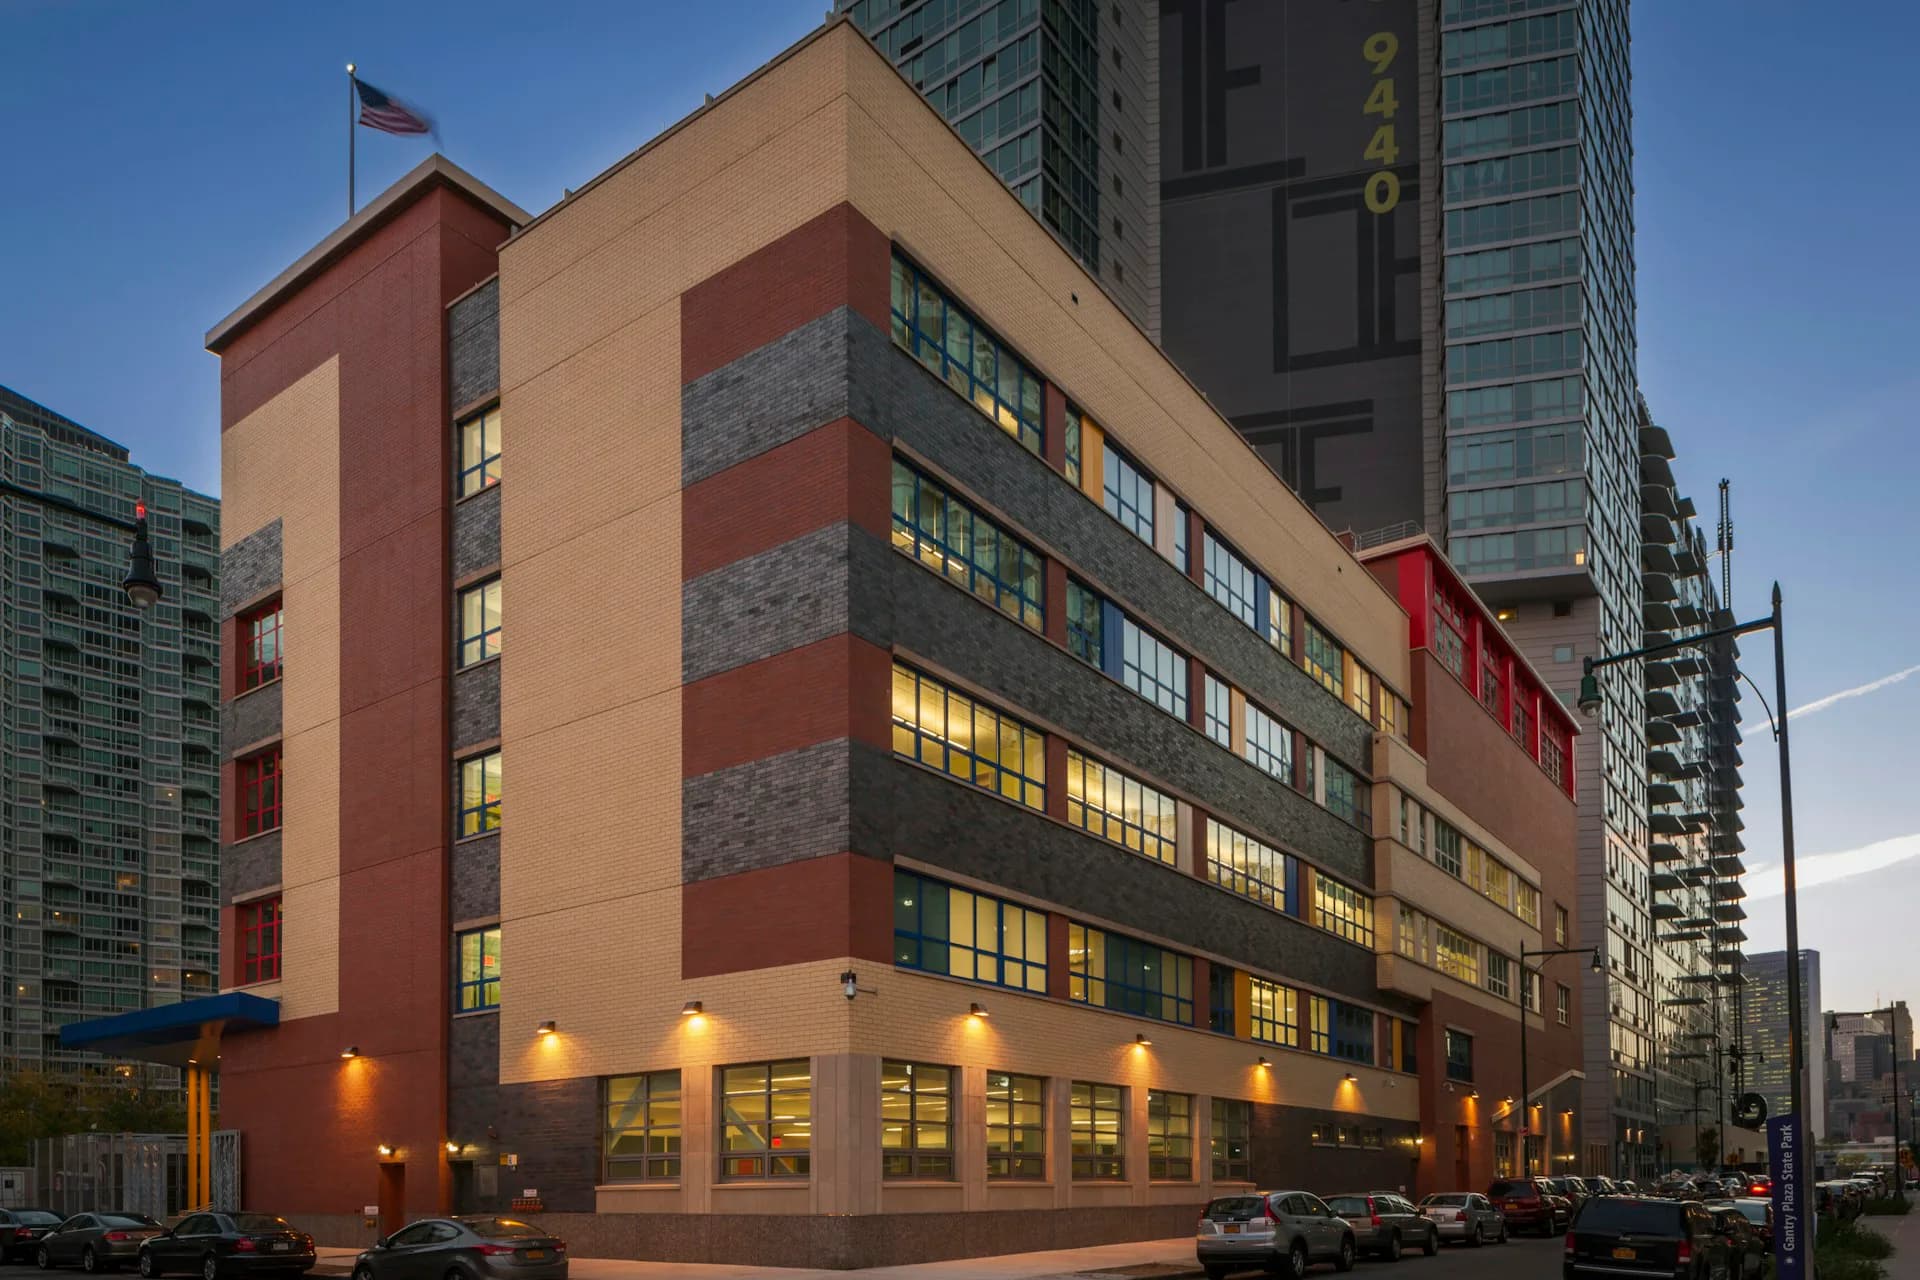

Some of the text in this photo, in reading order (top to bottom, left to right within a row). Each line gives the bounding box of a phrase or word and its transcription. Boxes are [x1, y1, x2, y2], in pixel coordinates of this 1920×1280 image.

[1363, 32, 1400, 214] 9440
[1780, 1124, 1797, 1251] Gantry Plaza State Park
